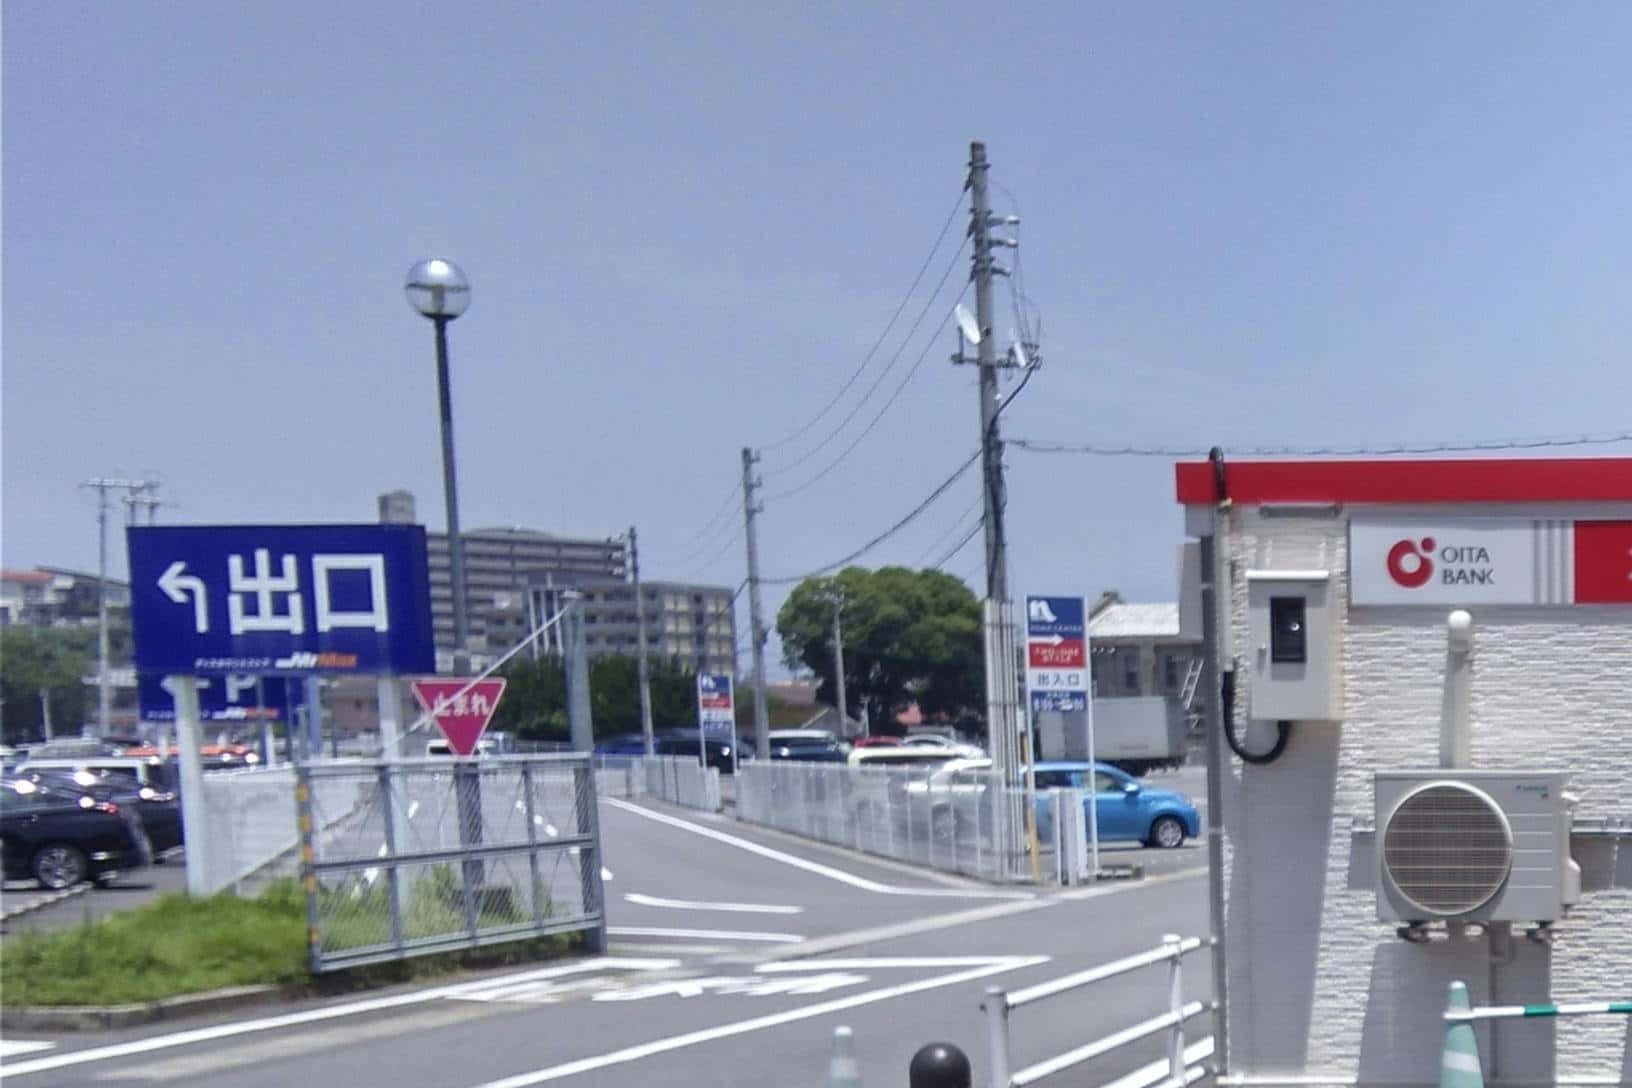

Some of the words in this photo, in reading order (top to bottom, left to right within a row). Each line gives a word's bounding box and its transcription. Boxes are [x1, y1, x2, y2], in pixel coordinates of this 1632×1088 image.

[1440, 546, 1489, 563] OITA
[1442, 568, 1494, 585] BANK
[227, 548, 389, 635] 出口
[1038, 672, 1080, 687] 出入口
